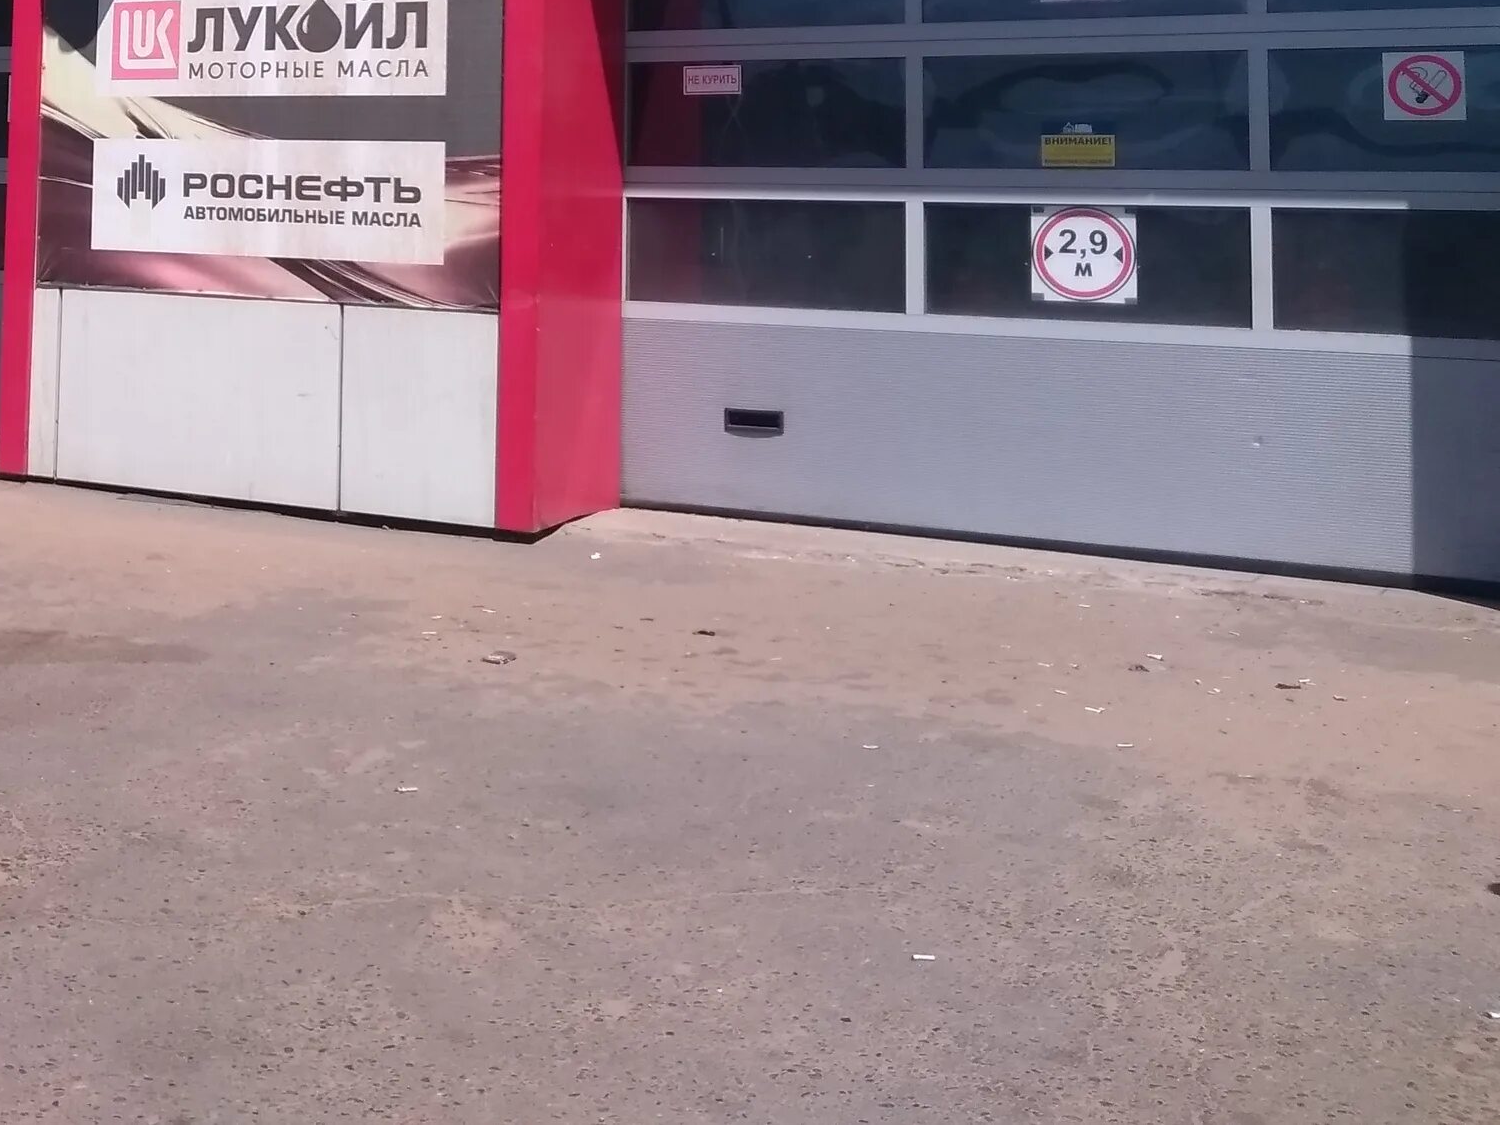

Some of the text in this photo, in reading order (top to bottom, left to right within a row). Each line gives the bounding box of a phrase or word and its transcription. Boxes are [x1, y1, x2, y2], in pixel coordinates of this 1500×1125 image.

[188, 59, 428, 80] МОТОРНЫЕ МАСЛА
[688, 75, 736, 84] НЕ КУРИТЬ
[1045, 137, 1112, 145] ВНИМАНИЕ!
[182, 172, 422, 204] РОСНЕФТЬ
[183, 205, 422, 228] АВТОМОБИЛЬНЫЕ МАСЛА
[1058, 230, 1108, 259] 2,9
